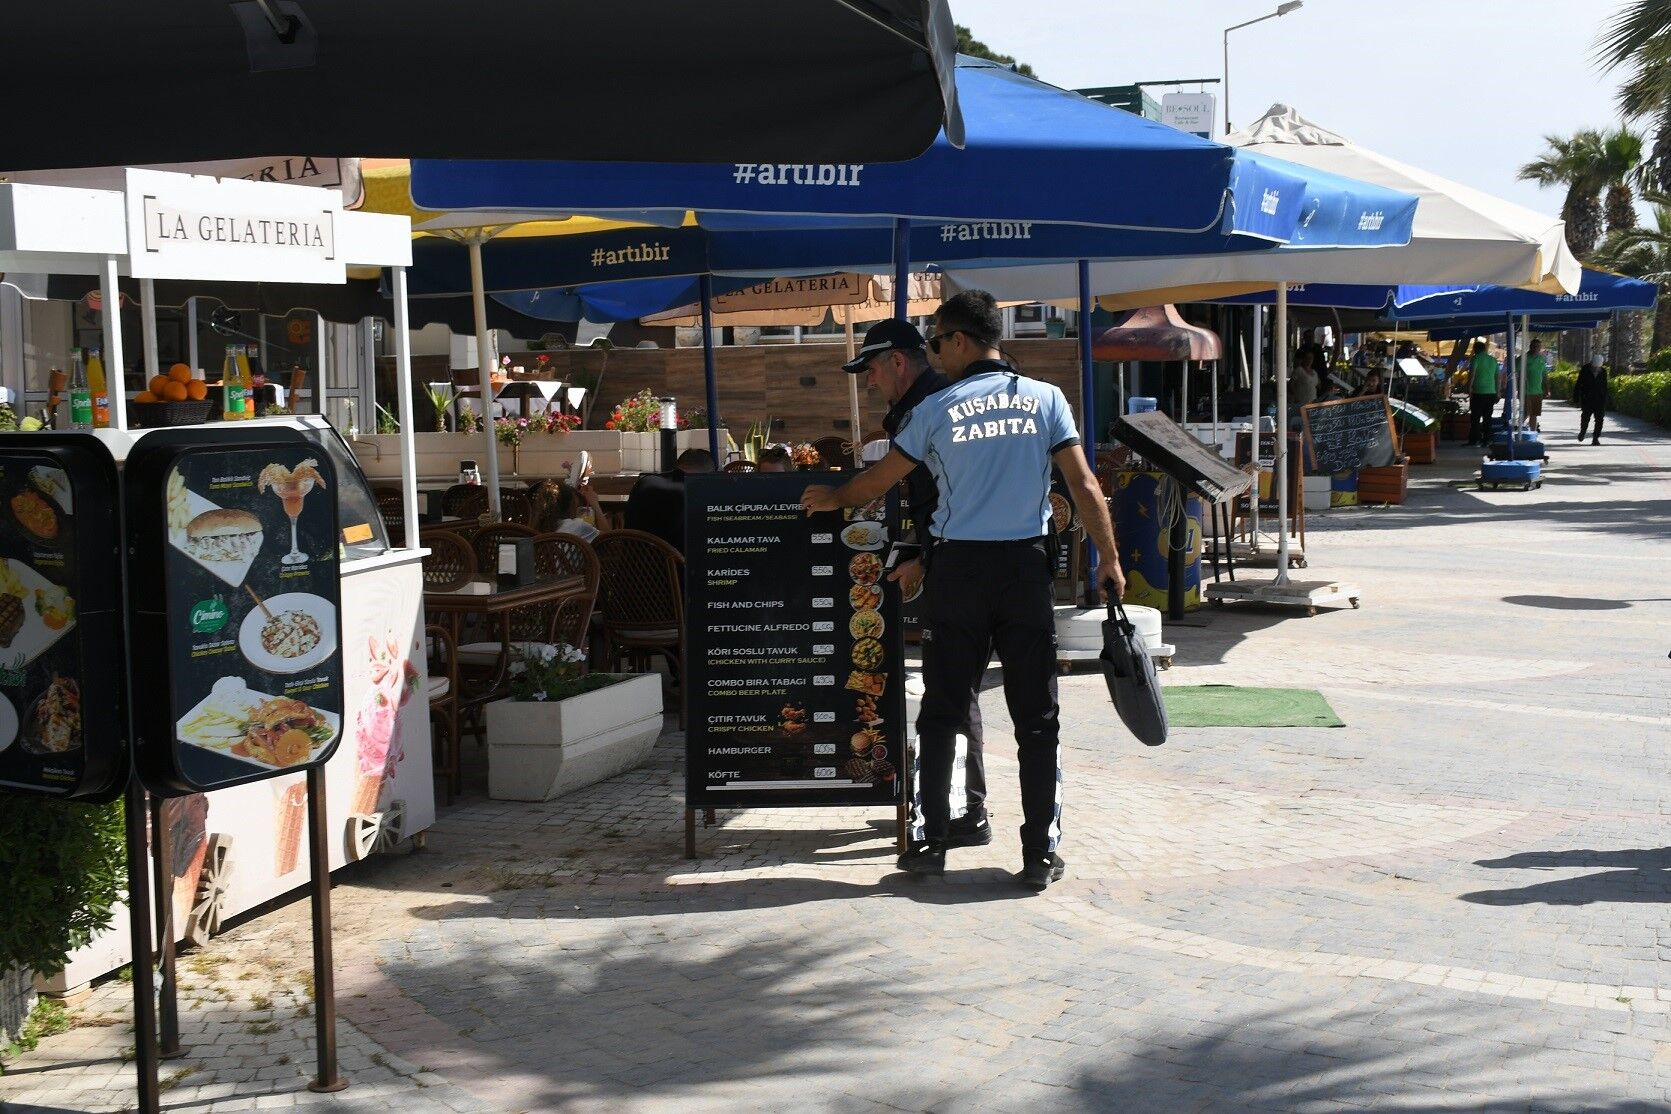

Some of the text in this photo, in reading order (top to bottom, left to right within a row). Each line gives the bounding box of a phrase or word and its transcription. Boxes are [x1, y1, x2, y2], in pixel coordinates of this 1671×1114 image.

[157, 212, 325, 247] LA GELATERIA
[752, 277, 850, 295] GELATERIA
[951, 417, 1038, 443] ZABITA
[707, 504, 734, 513] BALIK
[707, 536, 781, 545] KALAMAR TAVA
[707, 547, 730, 555] FRIED
[707, 600, 784, 609] FISH AND CHIPS
[707, 624, 762, 633] FETTUCINE
[764, 623, 810, 632] ALFREDO
[732, 646, 765, 656] SOSLU
[766, 646, 798, 655] TAVUK
[747, 657, 768, 665] WITH
[707, 678, 744, 687] COMBO
[745, 678, 770, 687] BIRA
[707, 689, 737, 697] COMBO
[763, 688, 787, 696] PLATE
[735, 714, 767, 723] TAVUK
[707, 725, 737, 733] CRISPY
[707, 746, 772, 755] HAMBURGER
[708, 770, 741, 779] KÖFTE
